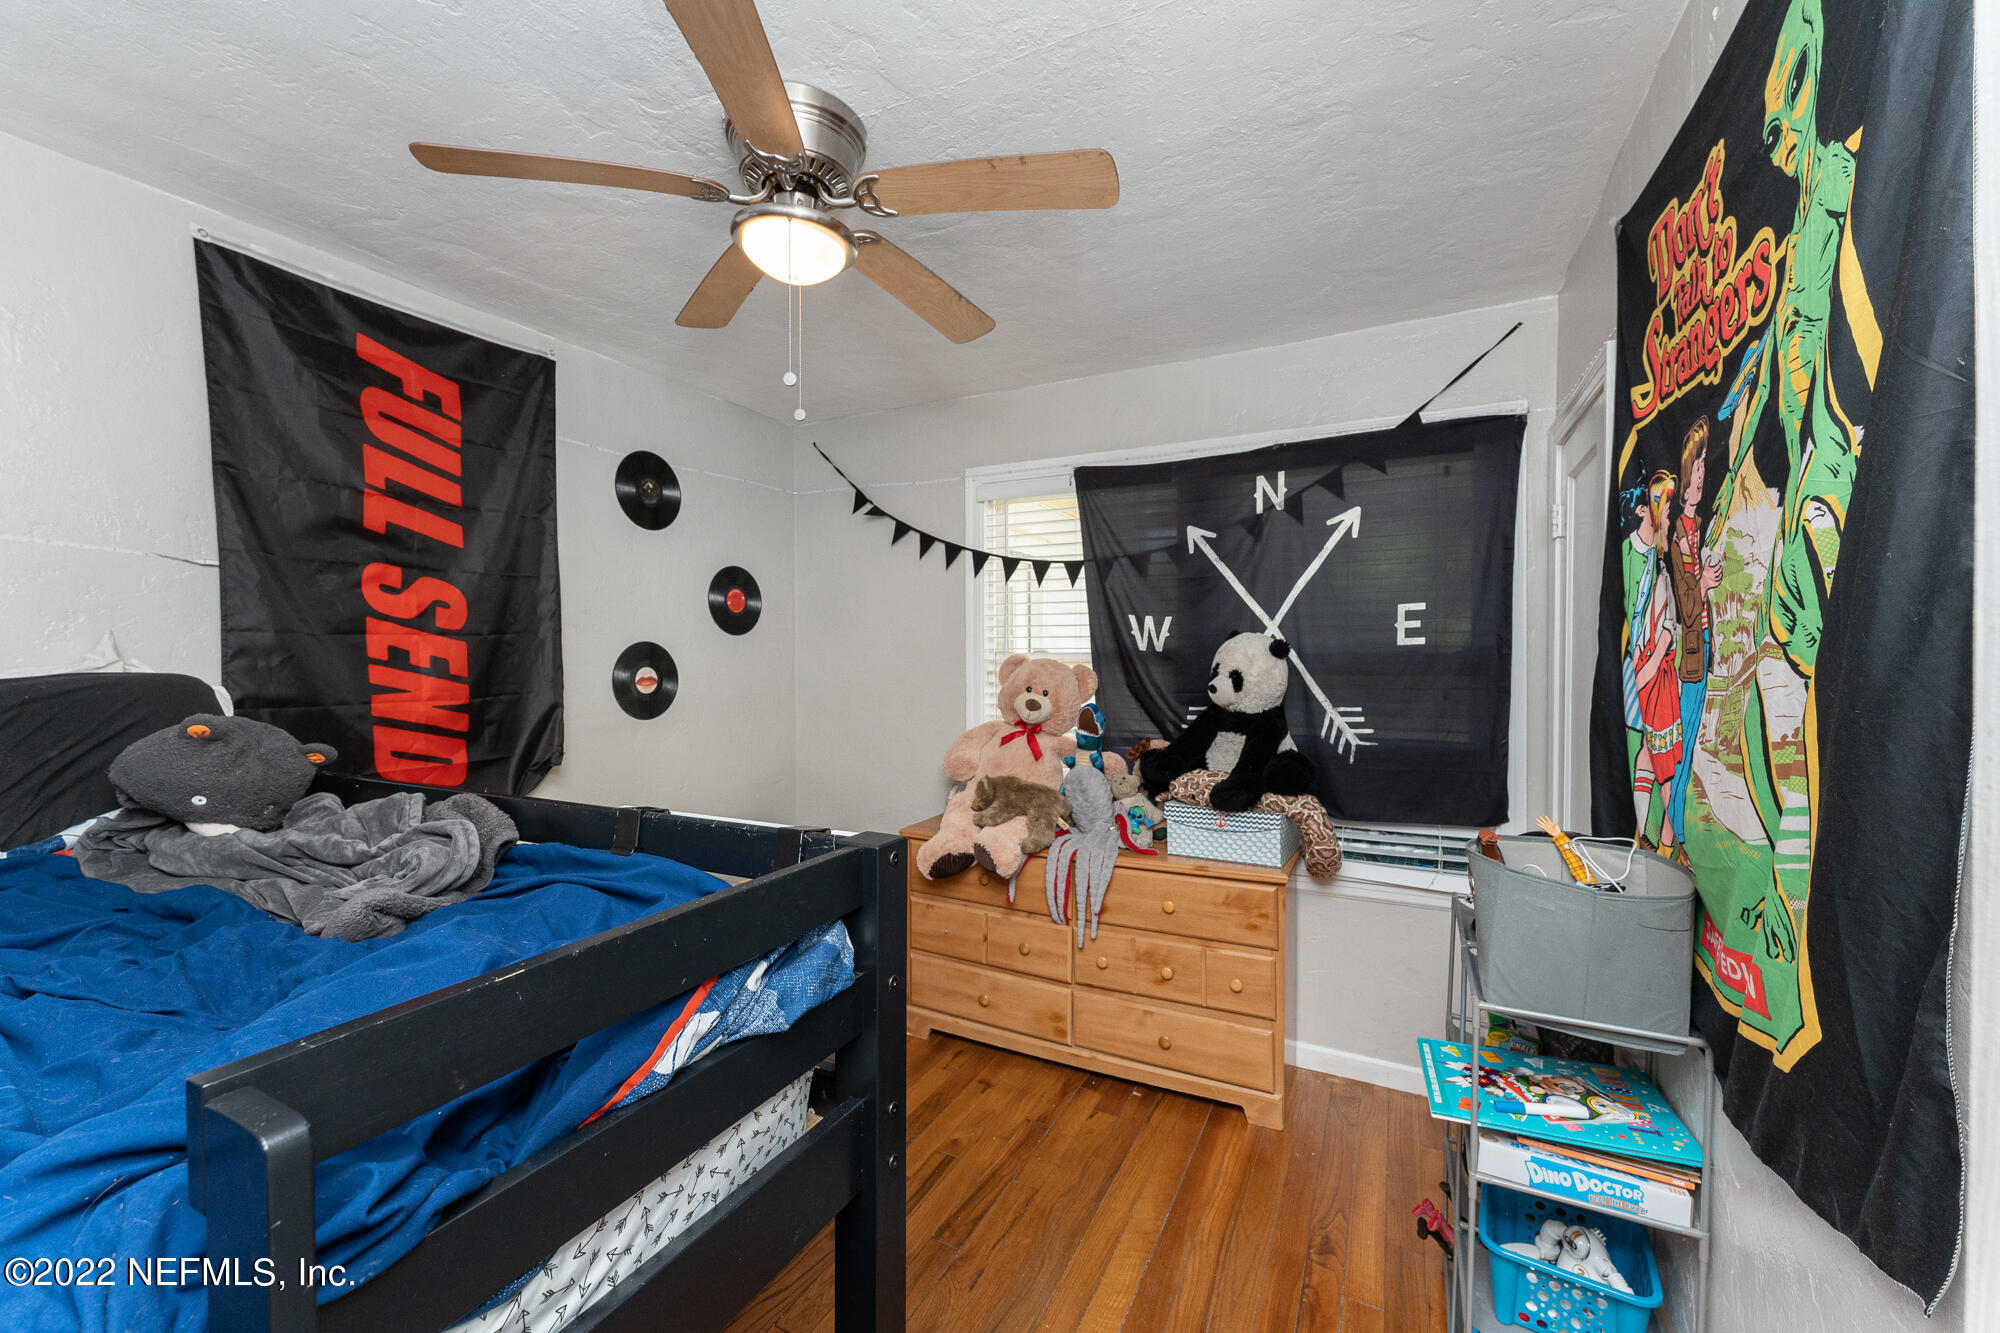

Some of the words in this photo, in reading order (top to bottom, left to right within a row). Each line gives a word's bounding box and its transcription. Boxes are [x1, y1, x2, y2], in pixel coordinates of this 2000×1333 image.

[1650, 149, 1720, 299] Don't
[1674, 256, 1714, 325] Talk
[1713, 228, 1733, 280] to
[1633, 242, 1772, 419] Strangers
[356, 332, 465, 548] FULL
[1253, 471, 1288, 514] N
[1129, 615, 1172, 652] W
[1394, 602, 1426, 646] E
[361, 562, 470, 787] SEND
[1572, 1171, 1643, 1201] DOCTOR
